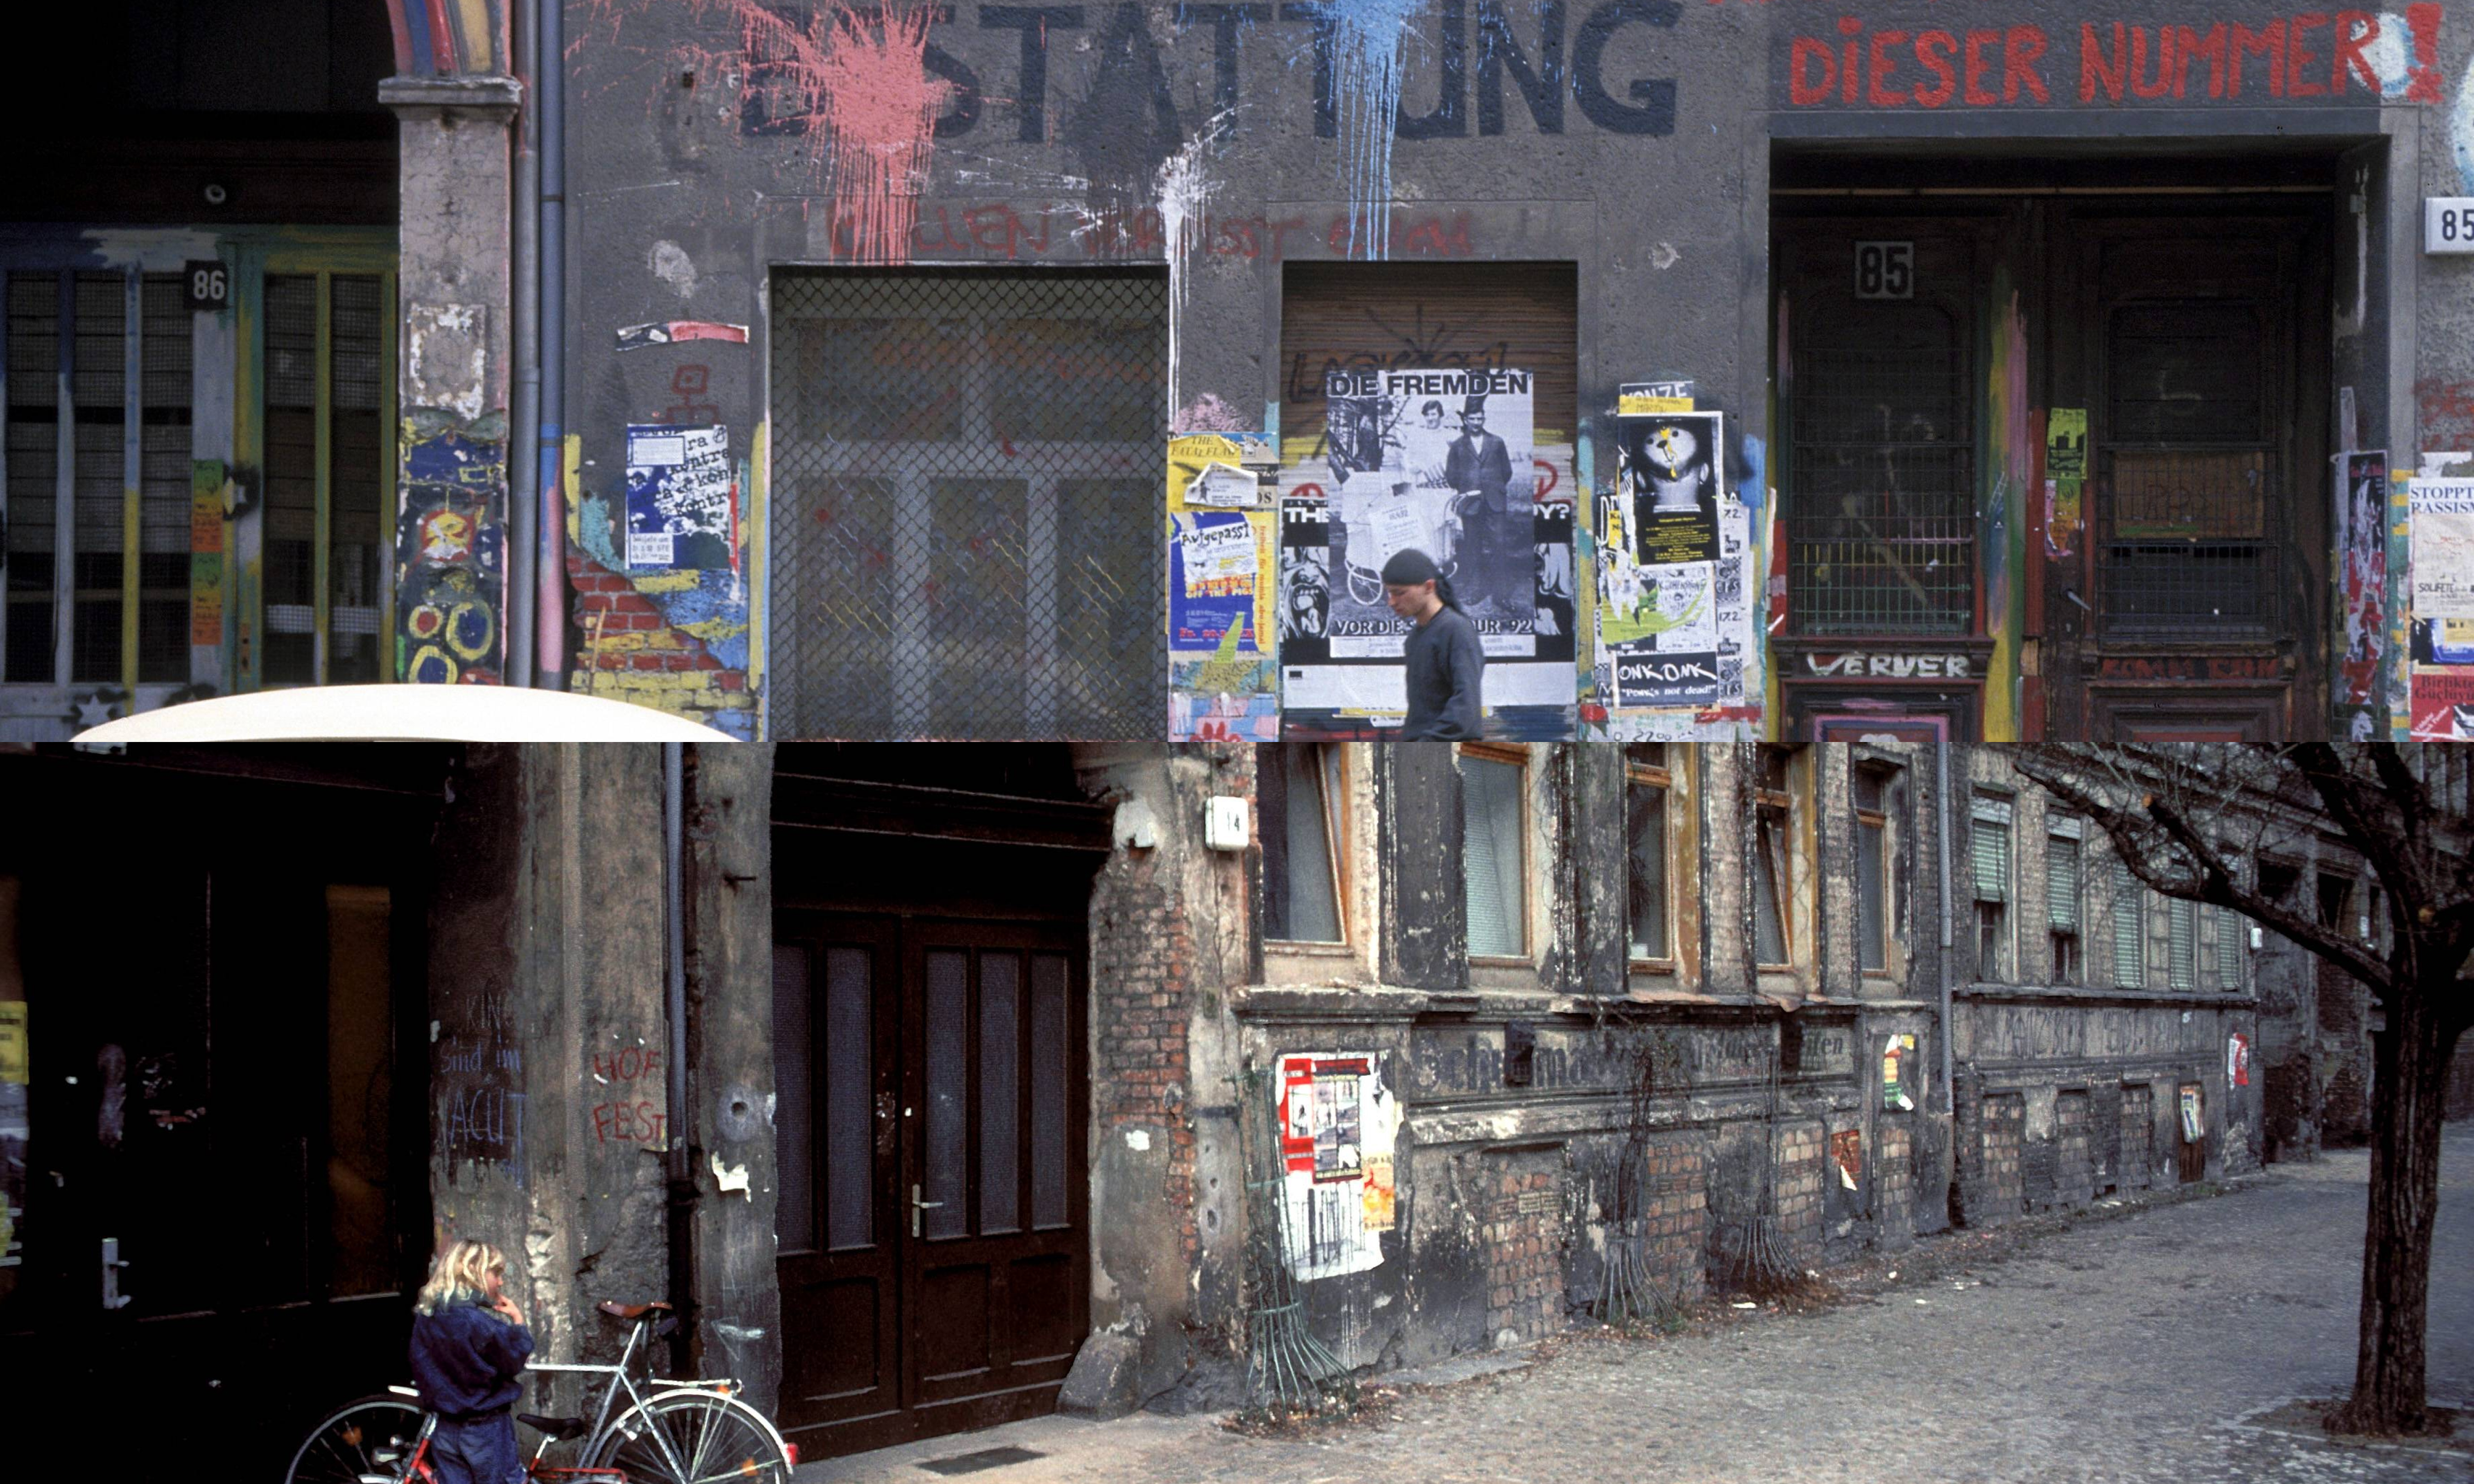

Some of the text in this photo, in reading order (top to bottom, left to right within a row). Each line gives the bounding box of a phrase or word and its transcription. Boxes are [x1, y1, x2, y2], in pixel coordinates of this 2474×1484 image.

[742, 0, 1679, 144] BSTATTUNG
[2442, 209, 2474, 241] 85
[193, 270, 225, 300] 86
[1860, 246, 1909, 296] 85
[1329, 373, 1528, 396] DIE FREMDEN
[1192, 436, 1214, 445] THE
[2410, 486, 2474, 499] STOPPT
[1334, 619, 1375, 635] VOR
[1378, 619, 1403, 635] DIE
[1510, 619, 1532, 634] 92
[1664, 687, 1681, 696] not
[595, 1046, 661, 1084] HOF
[594, 1102, 666, 1145] FEST
